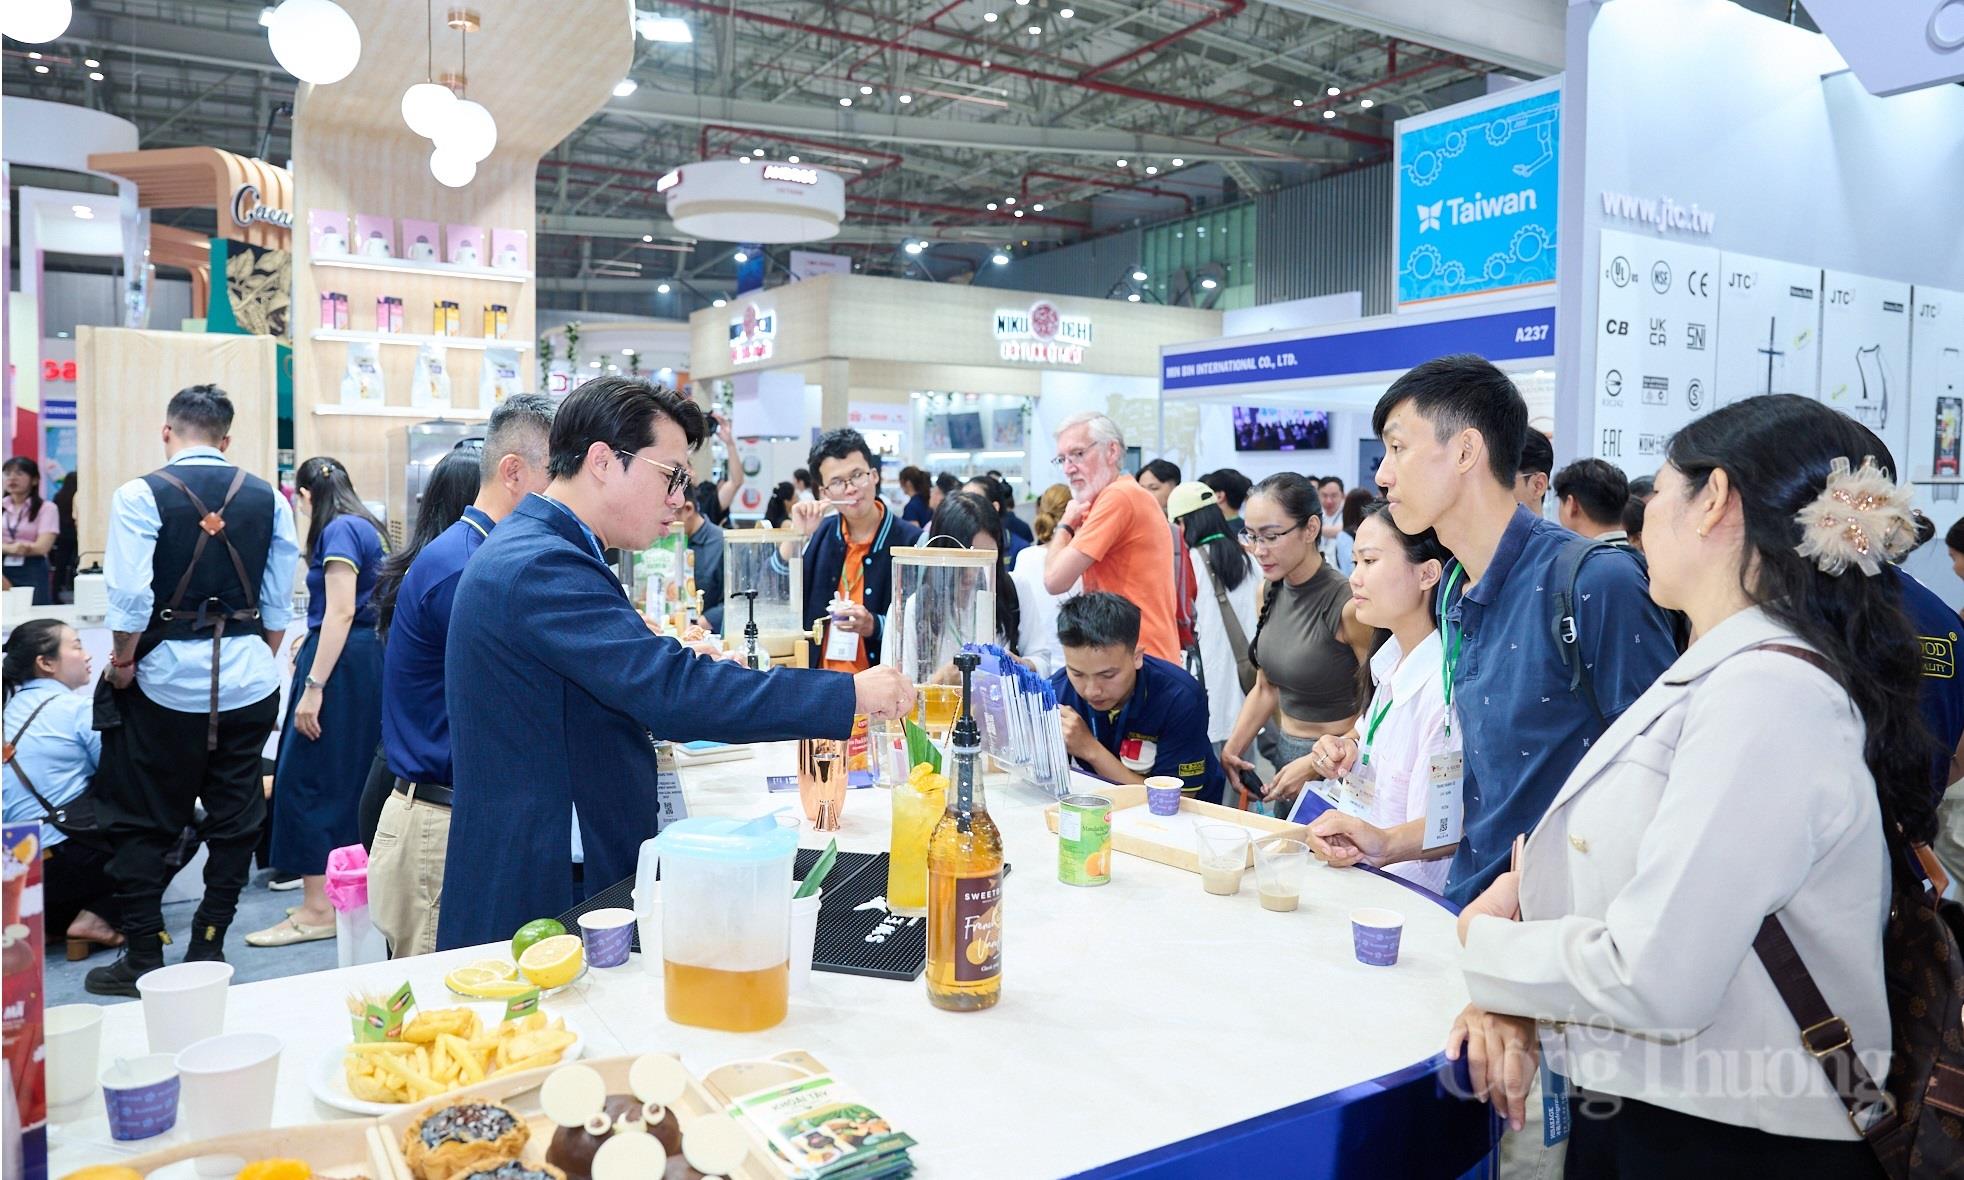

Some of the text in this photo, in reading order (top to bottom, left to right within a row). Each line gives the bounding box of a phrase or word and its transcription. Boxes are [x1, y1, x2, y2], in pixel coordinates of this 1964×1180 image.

[1447, 189, 1537, 225] Taiwan
[1601, 191, 1715, 233] www.jtc.tw
[1688, 270, 1708, 297] CE
[1728, 272, 1751, 289] JTC
[1830, 290, 1850, 305] JTC
[1919, 304, 1936, 318] JTC
[997, 315, 1029, 334] NIKU
[1606, 319, 1629, 336] CB
[1650, 317, 1667, 332] UK
[1515, 325, 1550, 342] A237
[1649, 332, 1667, 346] CA
[1196, 357, 1258, 376] INTERNATIONAL
[1257, 355, 1276, 370] CO.,
[1277, 352, 1299, 367] LTD.
[1602, 429, 1623, 457] EAC
